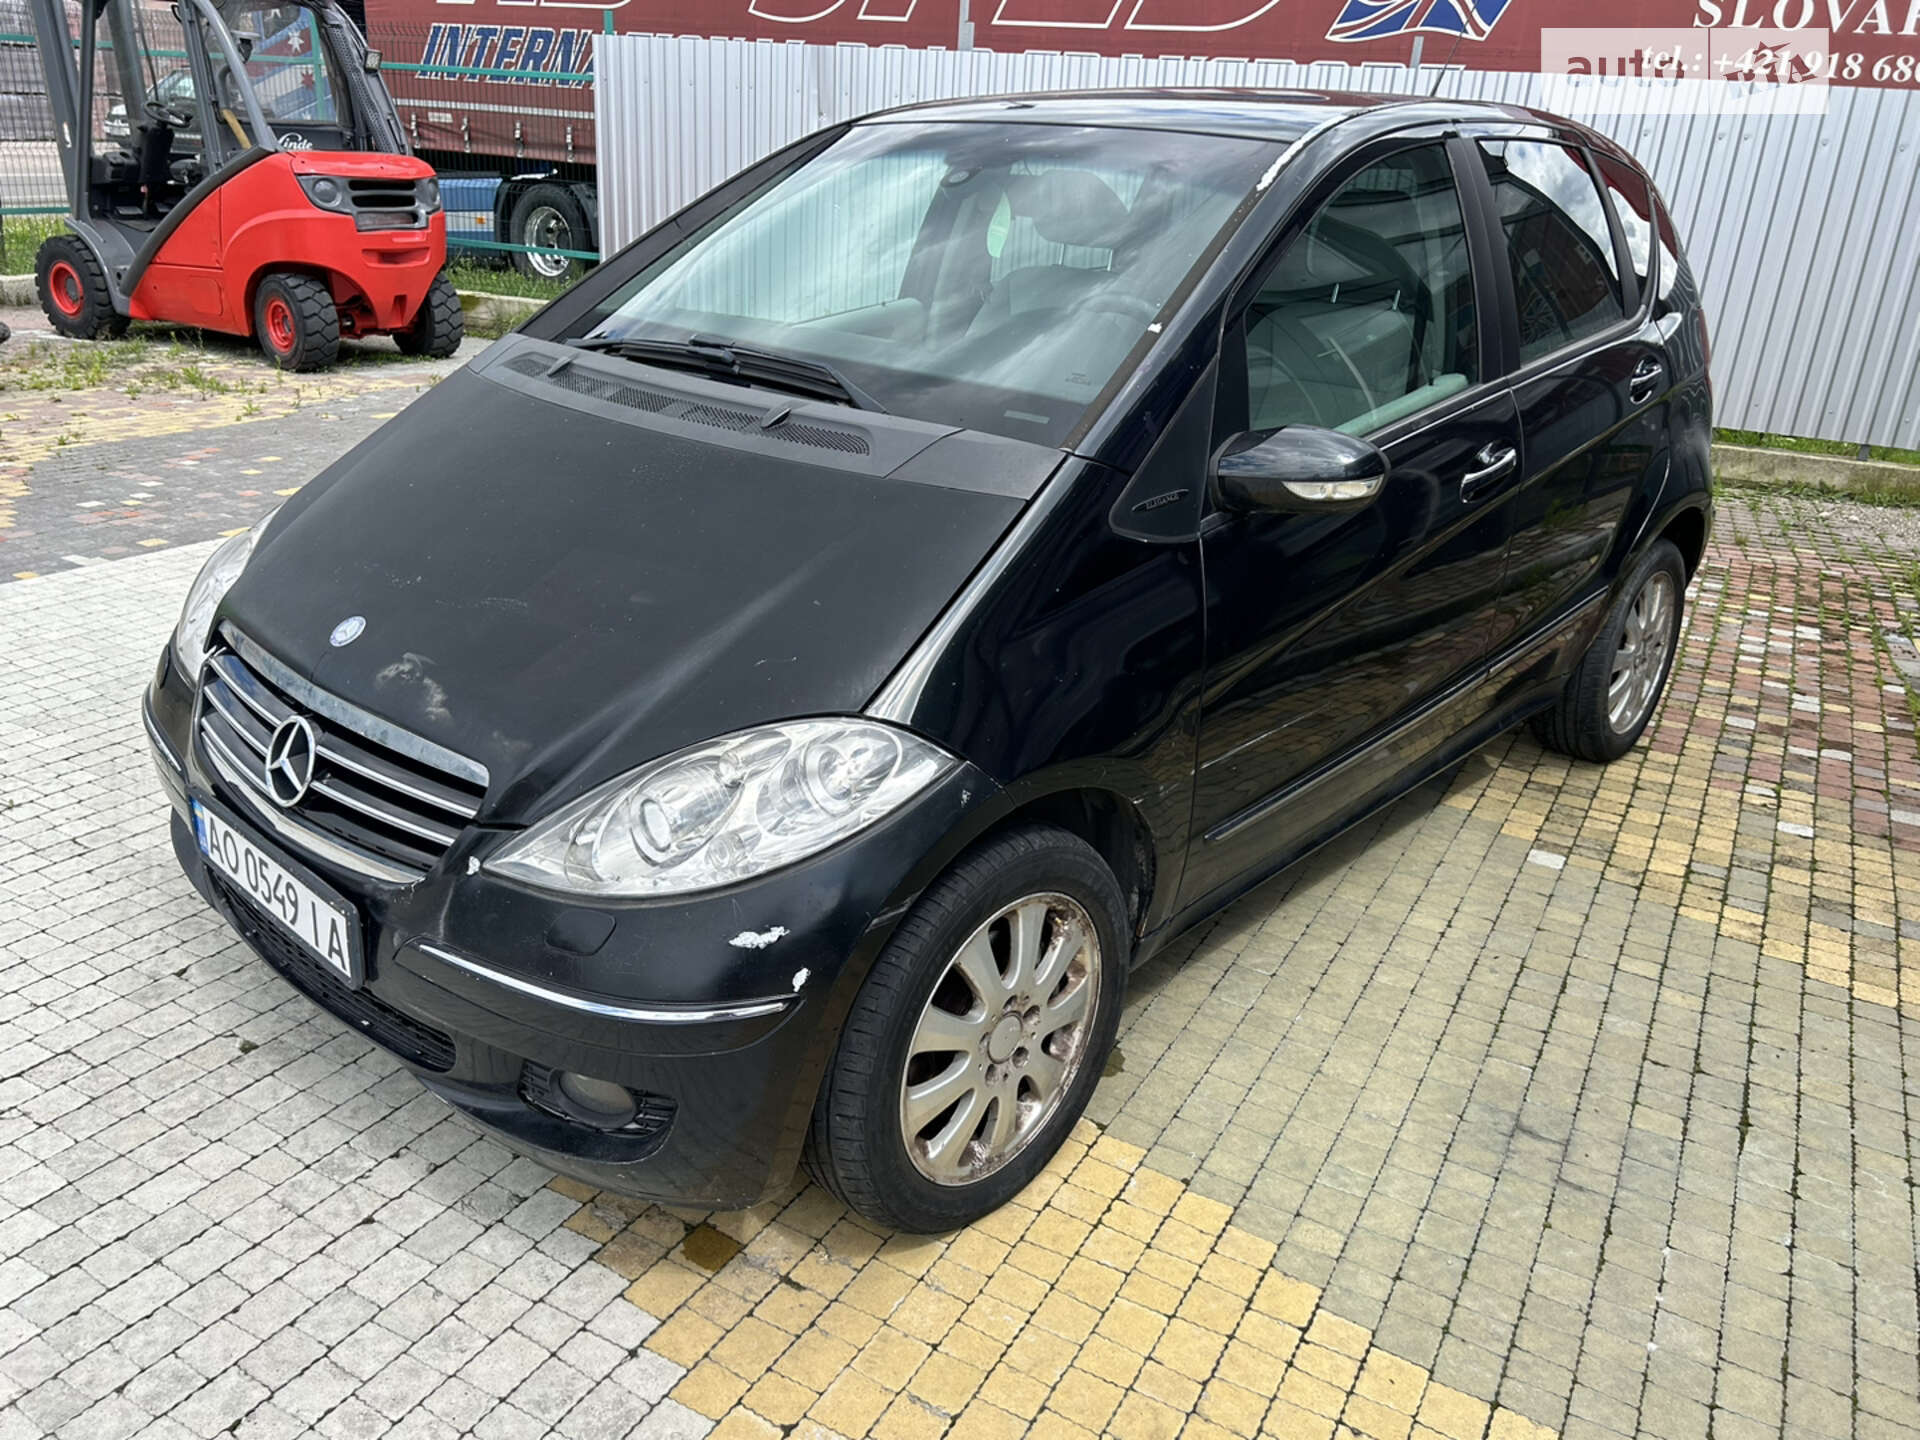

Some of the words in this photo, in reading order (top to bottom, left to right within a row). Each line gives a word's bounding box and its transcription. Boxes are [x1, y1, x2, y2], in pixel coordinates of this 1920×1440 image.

[415, 22, 596, 90] INTERN
[1713, 48, 1792, 76] +421
[1802, 51, 1865, 80] 918
[1872, 54, 1920, 84] 68
[209, 817, 239, 875] AO
[244, 847, 299, 926] 0549
